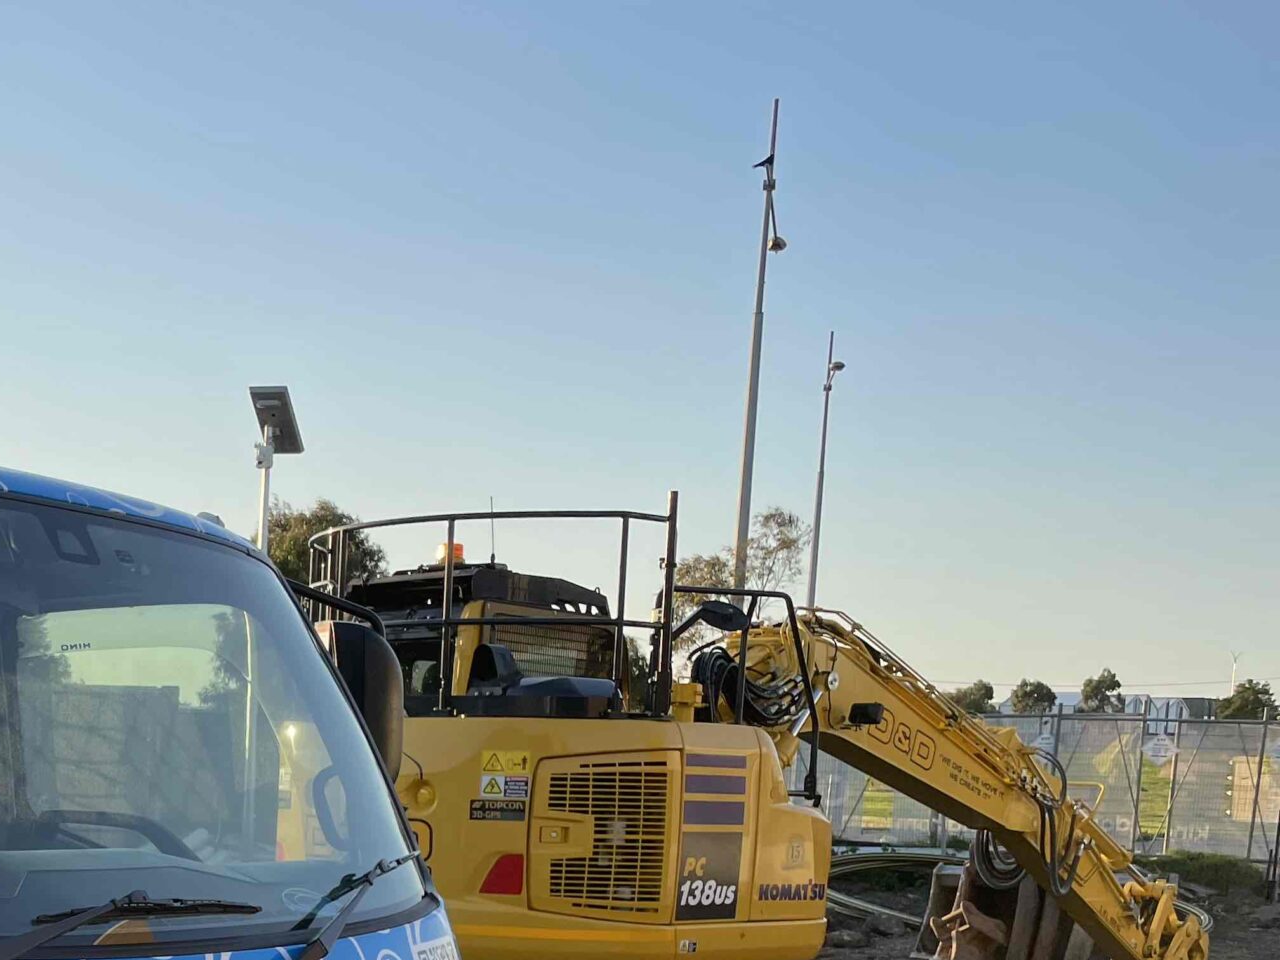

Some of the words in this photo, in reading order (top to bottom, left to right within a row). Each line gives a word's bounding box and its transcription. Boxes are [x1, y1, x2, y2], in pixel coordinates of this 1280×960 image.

[867, 707, 936, 771] D&D
[683, 856, 707, 877] PC
[758, 878, 826, 901] KOMATSU
